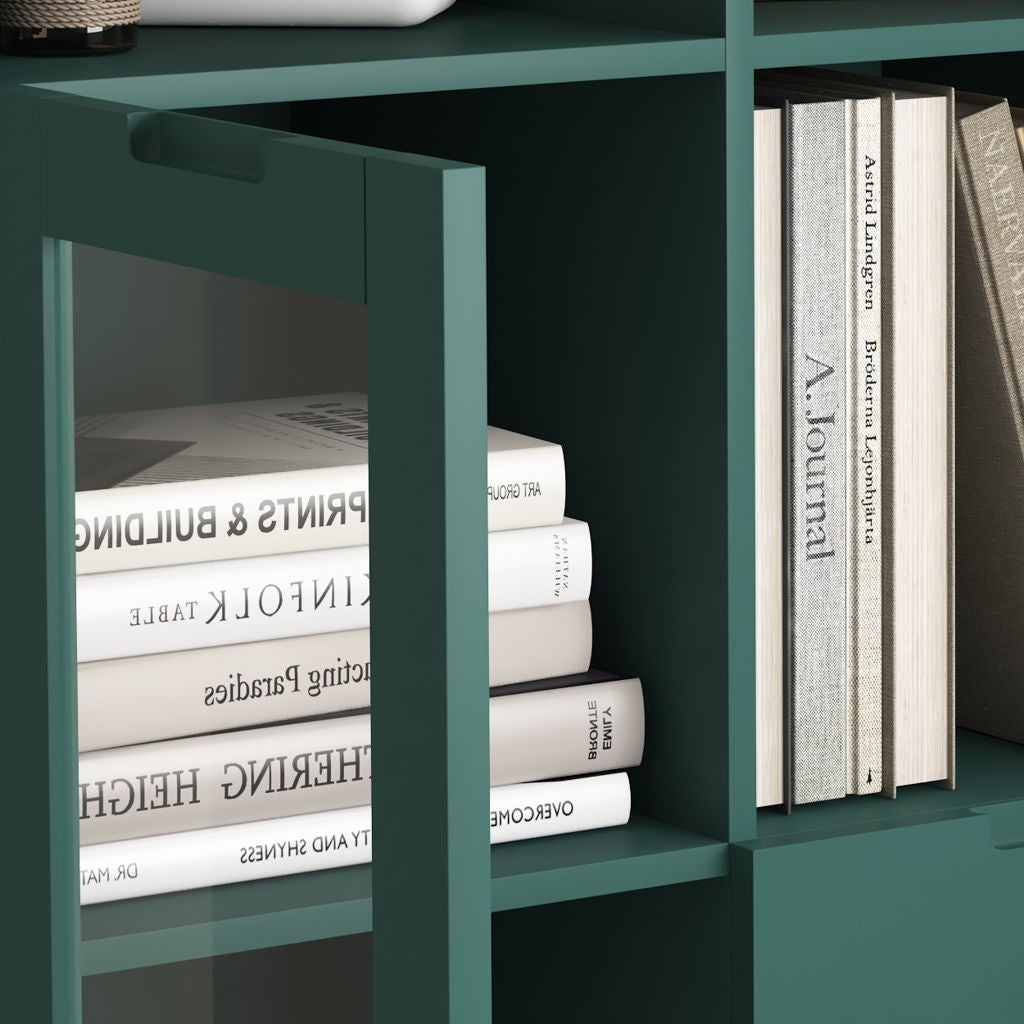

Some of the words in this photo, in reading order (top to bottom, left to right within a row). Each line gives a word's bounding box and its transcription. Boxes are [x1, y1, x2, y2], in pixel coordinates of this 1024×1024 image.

[865, 155, 877, 214] Astrid
[860, 221, 877, 310] Lindgren
[865, 340, 877, 428] Bröderna
[805, 410, 836, 561] Journal
[860, 436, 877, 545] Lejonhjärta
